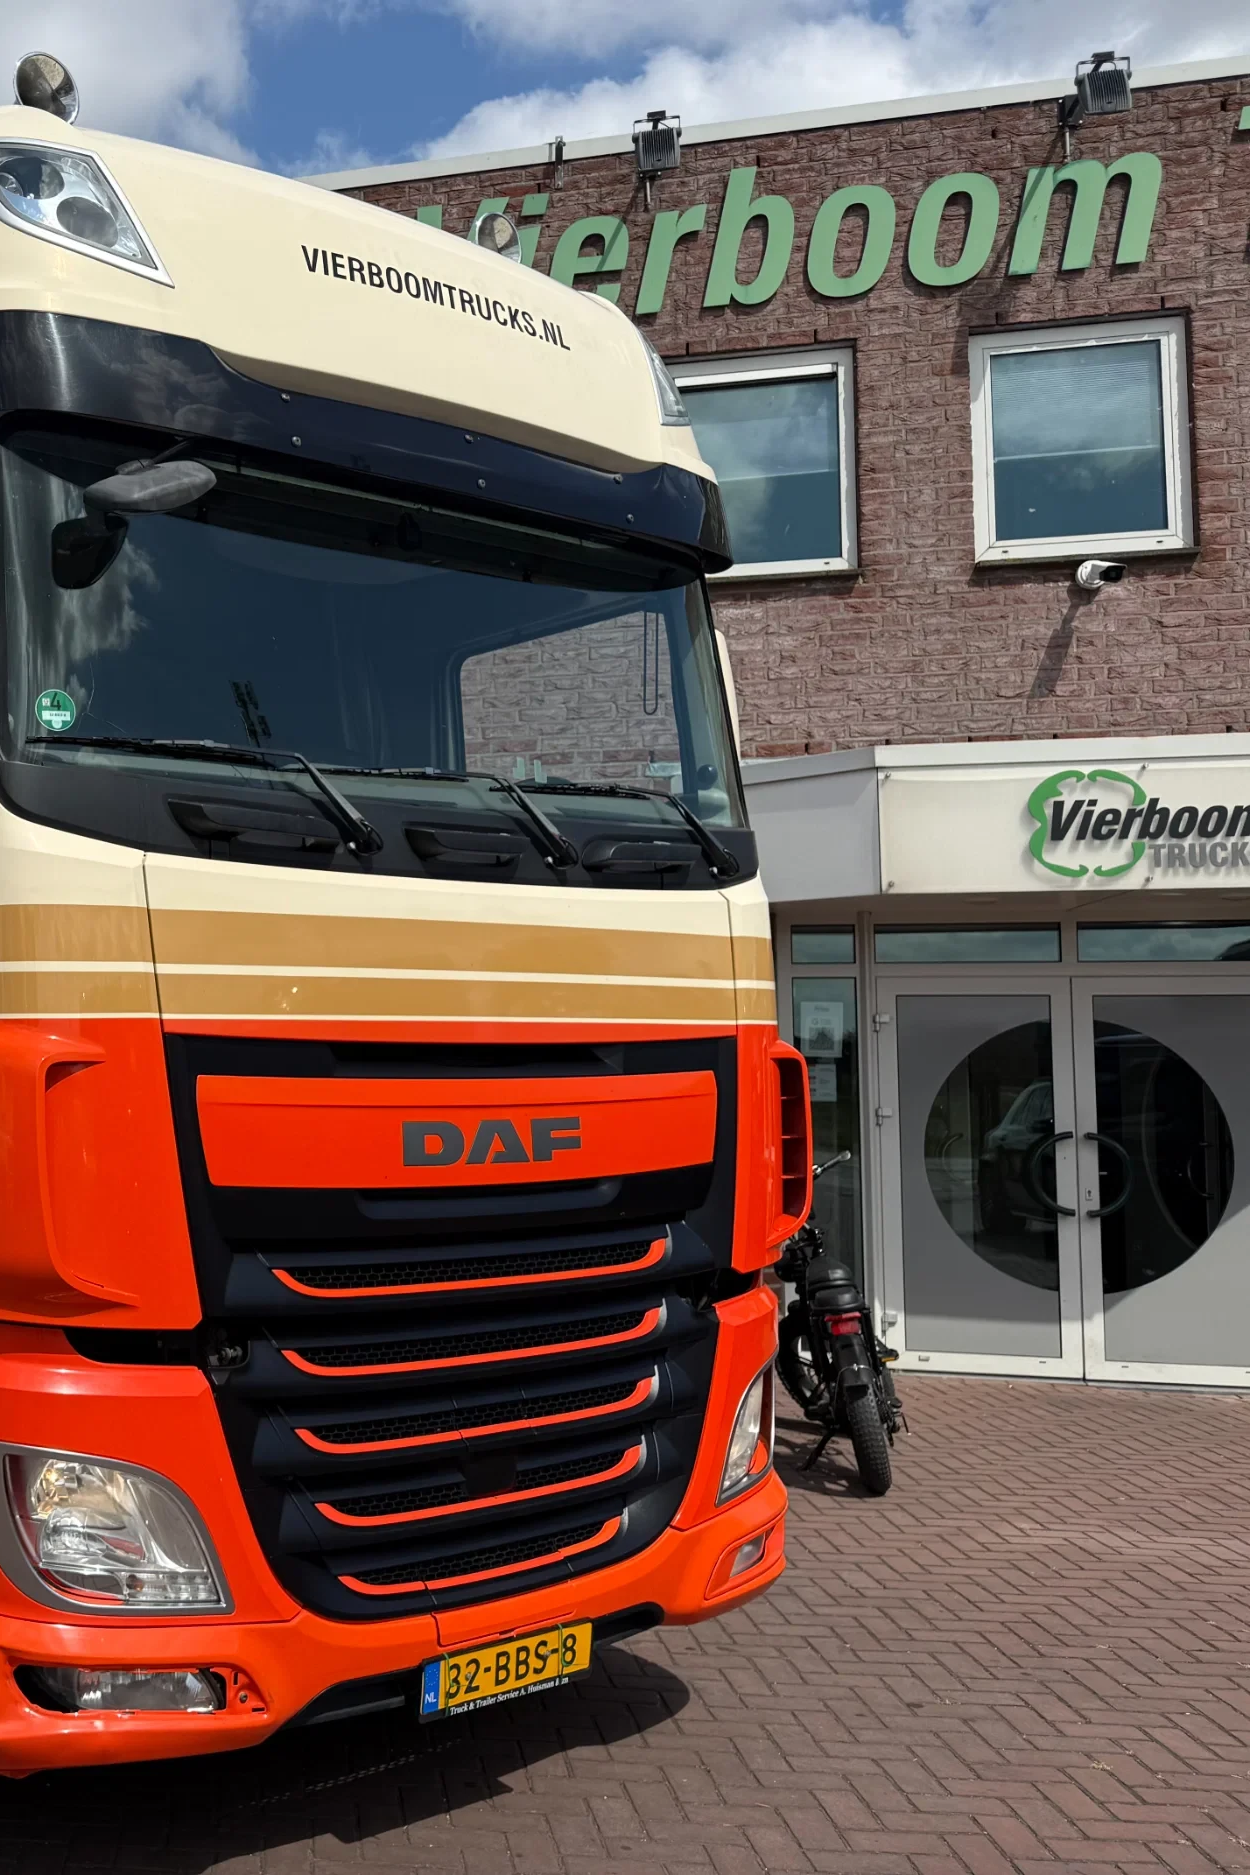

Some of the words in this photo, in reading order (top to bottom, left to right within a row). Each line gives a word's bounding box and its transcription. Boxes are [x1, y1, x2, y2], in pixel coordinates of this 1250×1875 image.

[417, 152, 1162, 315] erboom
[301, 245, 571, 351] VIERBOOMTRUCKS.NL
[50, 692, 62, 711] 4
[401, 1116, 582, 1167] DAF
[446, 1633, 577, 1700] 32-BBS-8
[425, 1692, 437, 1705] NL
[450, 1703, 469, 1716] Truck
[475, 1696, 497, 1709] Trailer
[496, 1690, 520, 1703] Service
